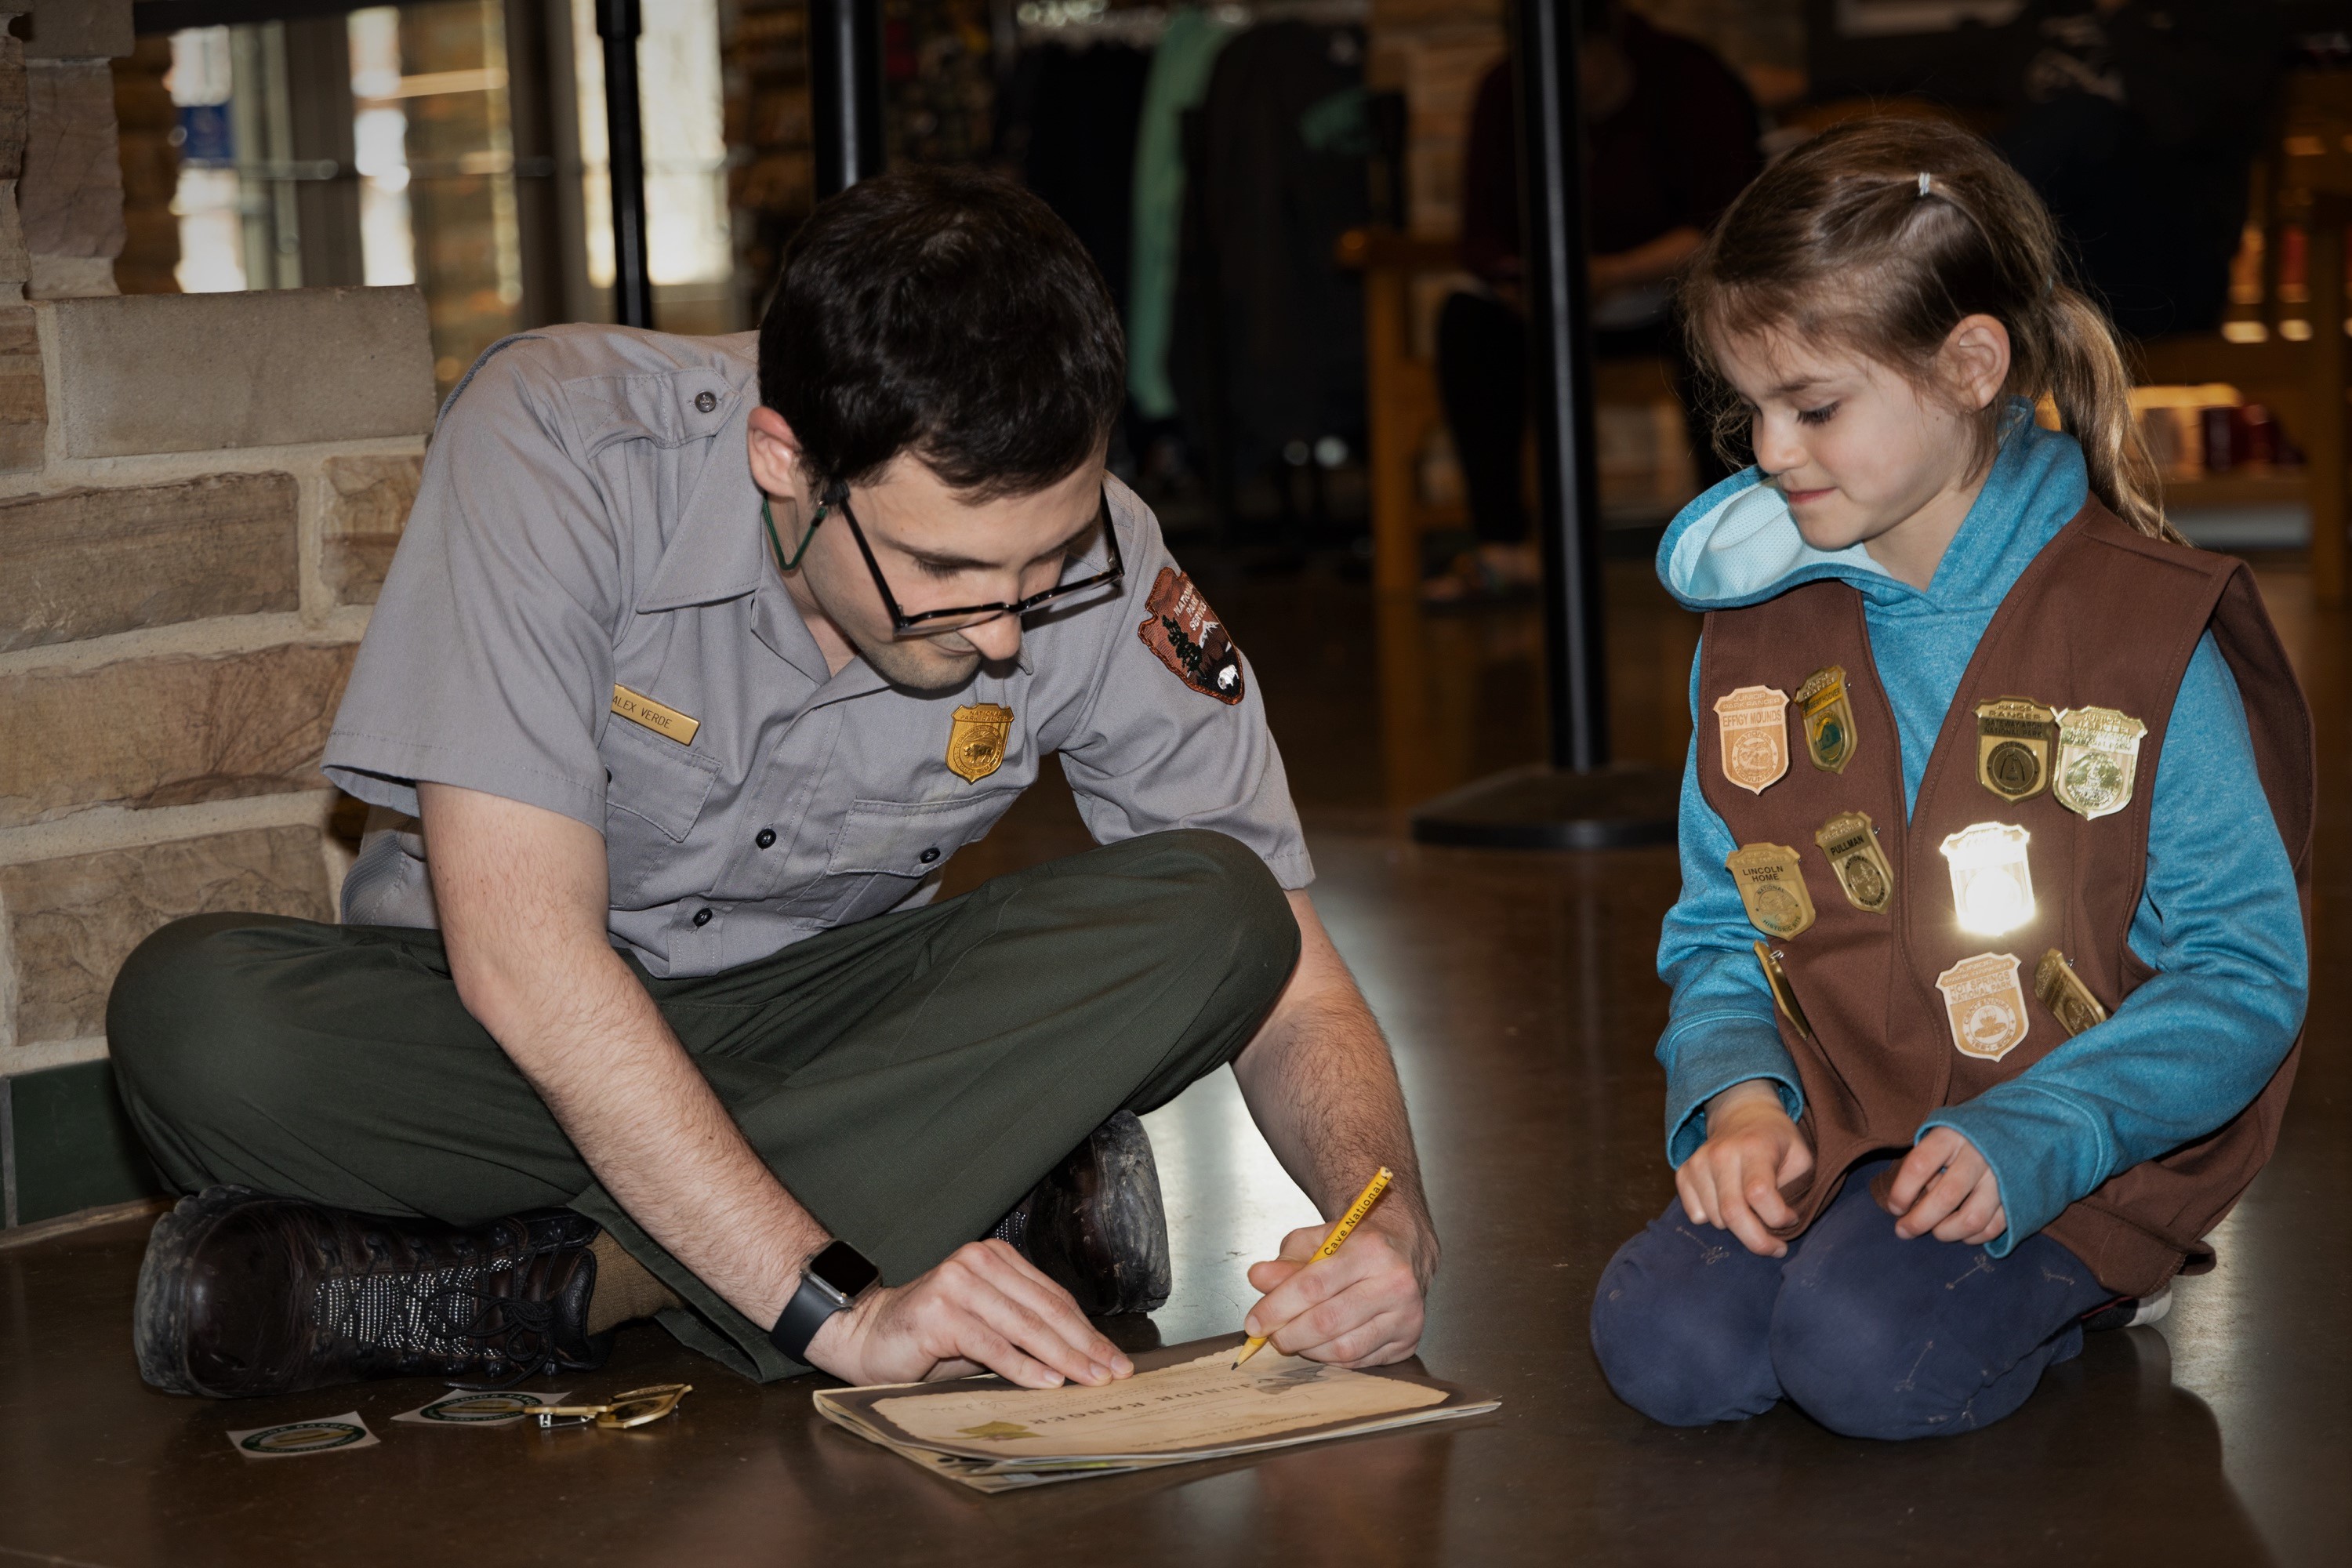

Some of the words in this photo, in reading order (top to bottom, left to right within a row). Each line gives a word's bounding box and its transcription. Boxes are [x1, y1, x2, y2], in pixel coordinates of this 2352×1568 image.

[1733, 693, 1766, 702] JUNIOR
[1746, 698, 1780, 706] RANGER
[612, 695, 637, 713] ALEX
[641, 707, 673, 729] VERDE
[1722, 714, 1748, 728] EFFIGY
[1750, 710, 1782, 724] MOUNDS
[1989, 710, 2042, 720] RANGER
[1985, 719, 2019, 728] GATEWAY
[1984, 728, 2020, 737] NATIONAL
[2023, 730, 2042, 739] PARK
[1830, 835, 1864, 856] PULLMAN
[1846, 855, 1869, 869] NATIONAL
[1742, 866, 1784, 876] LINCOLN
[1751, 873, 1780, 883] HOME
[1757, 885, 1784, 895] NATIONAL
[1762, 919, 1792, 932] HISTORIC
[1792, 915, 1802, 928] SITE
[1957, 959, 1994, 974] JUNIOR
[1949, 982, 1969, 994] HOT
[1970, 971, 2011, 989] SPRINGS
[1951, 988, 1991, 1003] NATIONAL
[1991, 981, 2012, 992] PARK
[1323, 1229, 1348, 1256] Cave
[1345, 1181, 1383, 1227] National
[444, 1394, 499, 1404] JUNIOR
[1156, 1383, 1250, 1402] JUNIOR
[1029, 1402, 1145, 1425] RANGER
